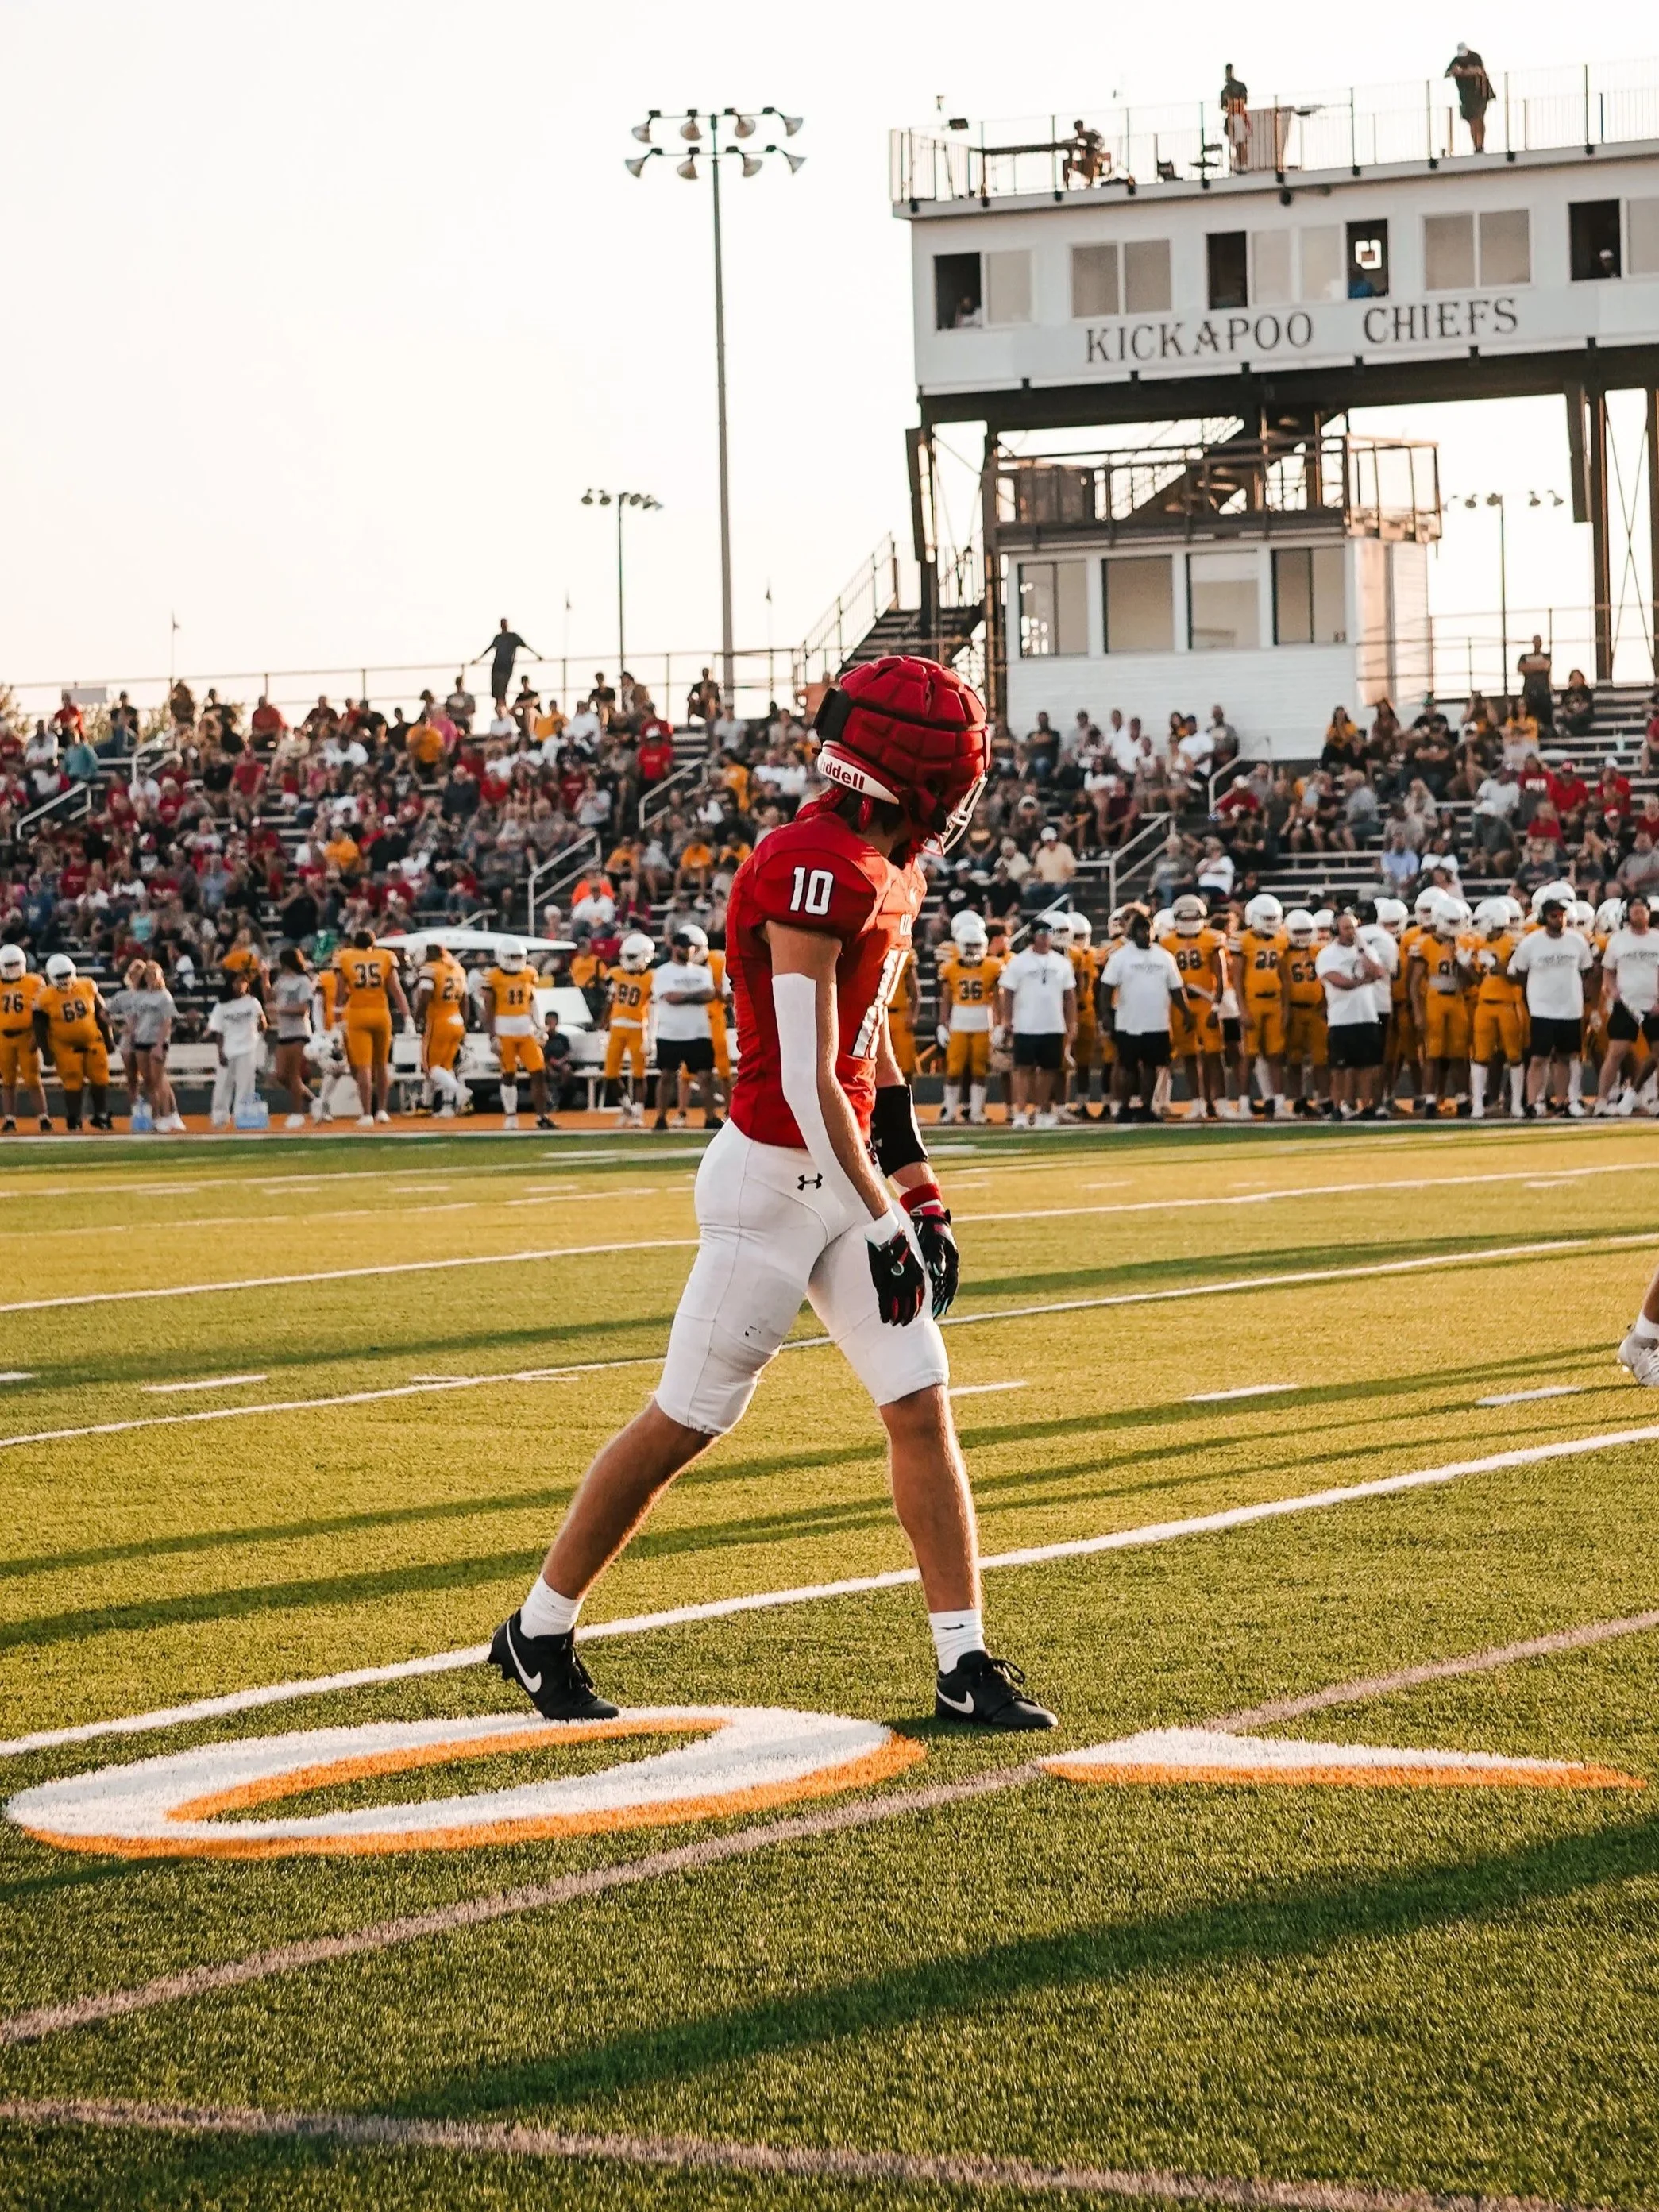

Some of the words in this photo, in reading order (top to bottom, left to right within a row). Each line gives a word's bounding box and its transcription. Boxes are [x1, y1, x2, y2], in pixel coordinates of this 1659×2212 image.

[1086, 311, 1313, 364] KICKAPOO
[1364, 297, 1518, 344] CHIEFS
[789, 867, 834, 916] 10
[353, 963, 383, 989] 35
[959, 979, 983, 1001] 36
[2, 993, 24, 1014] 76
[63, 998, 87, 1024] 69
